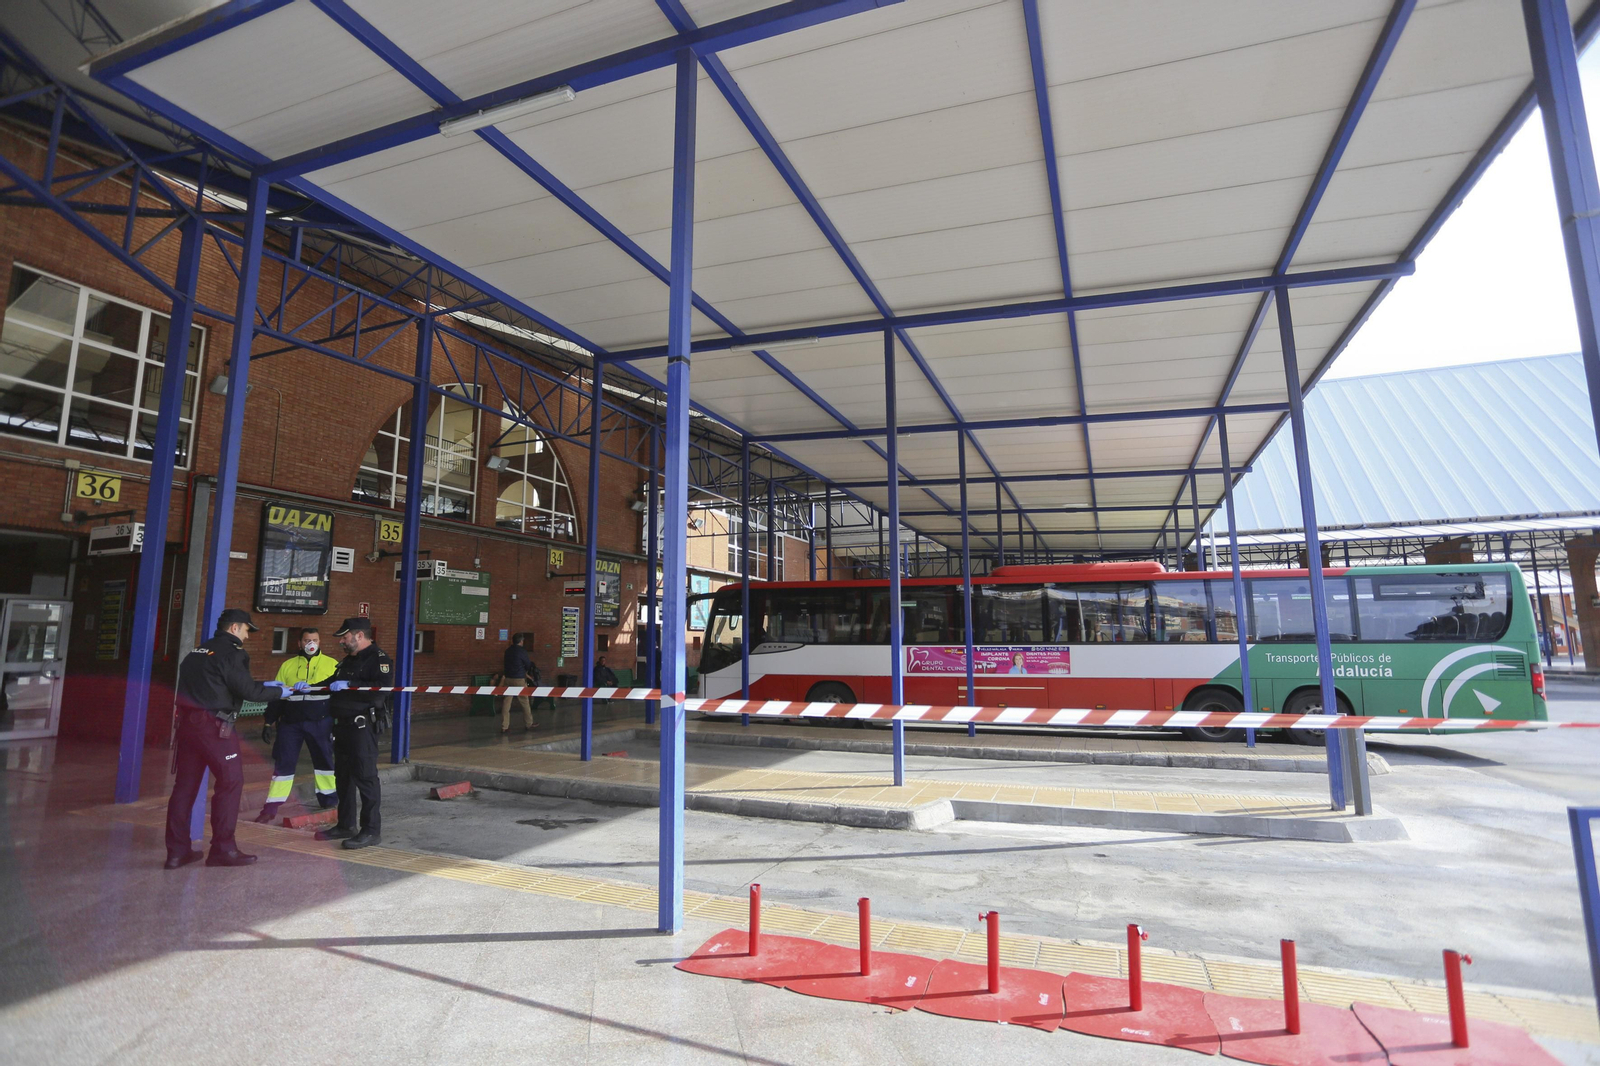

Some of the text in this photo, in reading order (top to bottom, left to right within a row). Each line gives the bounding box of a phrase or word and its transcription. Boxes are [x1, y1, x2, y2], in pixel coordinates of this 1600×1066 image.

[80, 475, 115, 499] 36
[268, 506, 332, 532] DAZN
[116, 525, 125, 535] 36
[382, 523, 399, 540] 35
[551, 552, 562, 565] 34
[437, 567, 445, 575] 35
[595, 560, 620, 574] DAZN
[1265, 652, 1392, 664] Transporte Públicos de
